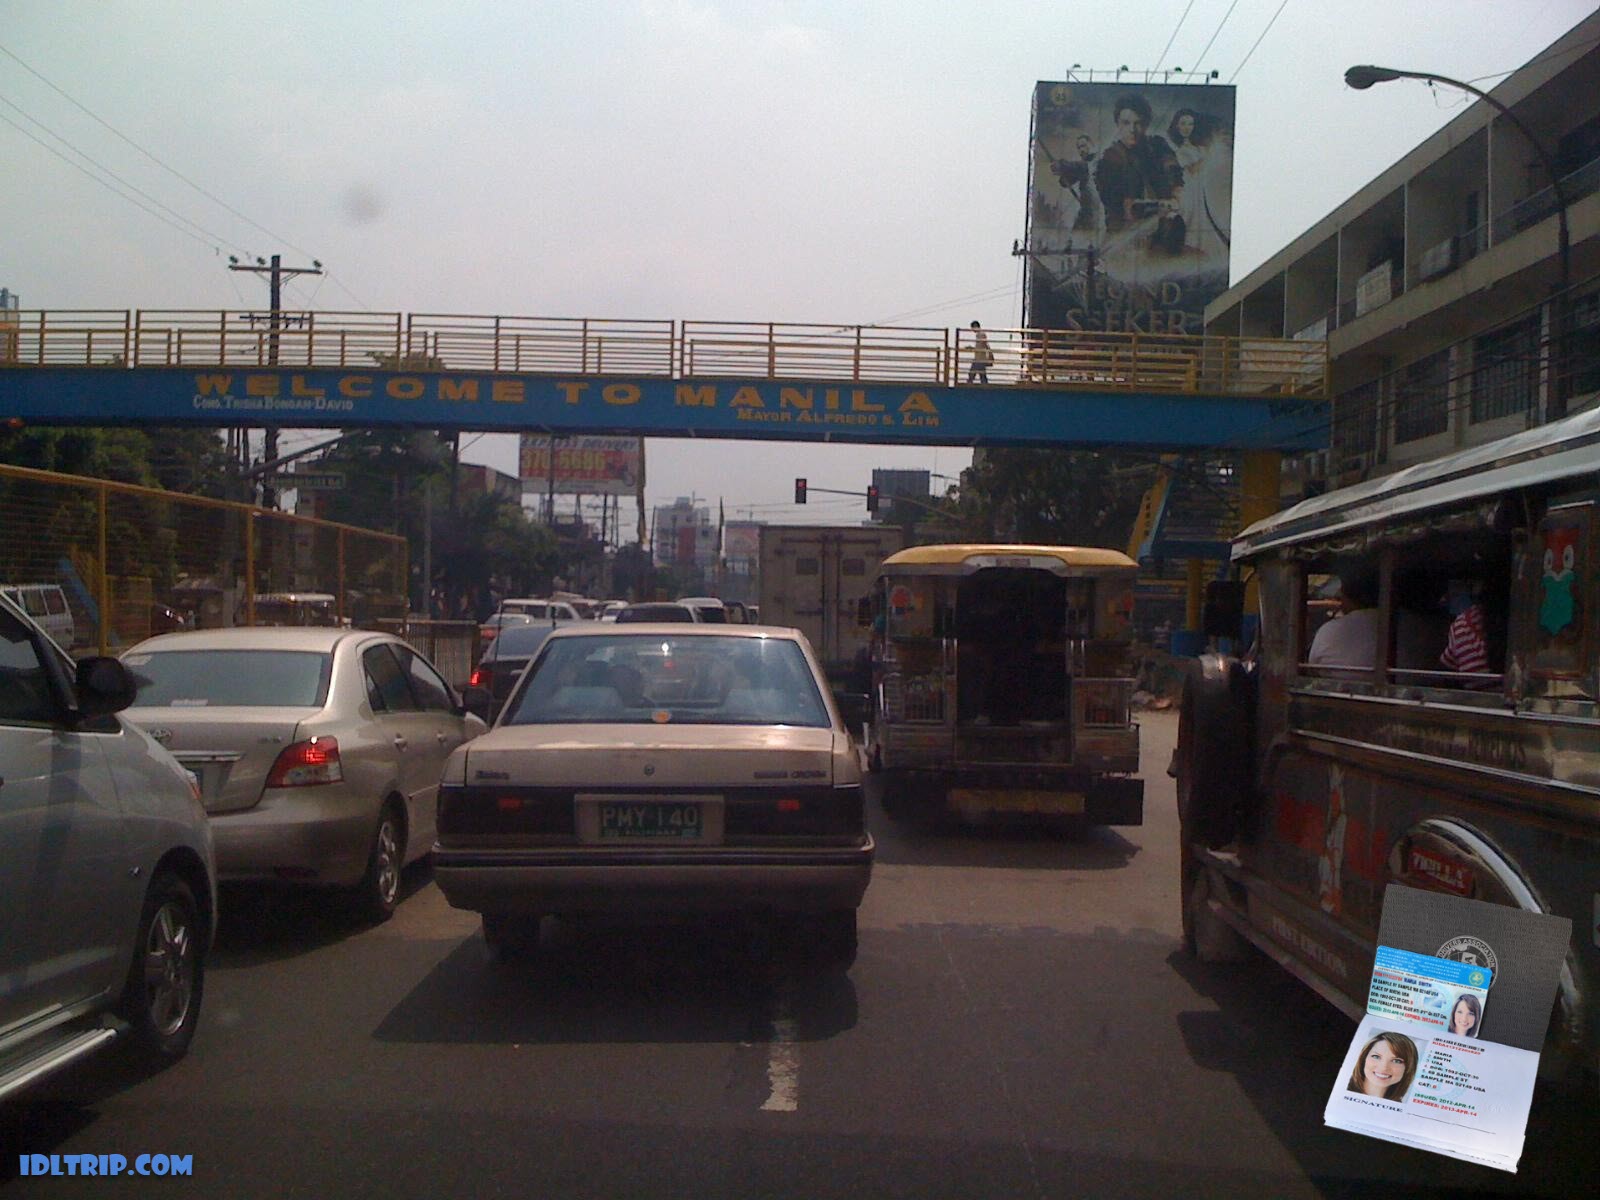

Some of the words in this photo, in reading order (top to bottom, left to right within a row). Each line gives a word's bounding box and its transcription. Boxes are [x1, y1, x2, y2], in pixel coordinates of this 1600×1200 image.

[194, 373, 525, 403] WELCOME
[556, 383, 642, 405] TO
[675, 385, 939, 412] MANILA
[736, 407, 791, 422] MAYOR
[796, 409, 877, 425] ALFREDO
[902, 411, 940, 426] LIM
[602, 806, 647, 828] PMY
[657, 806, 698, 827] 140
